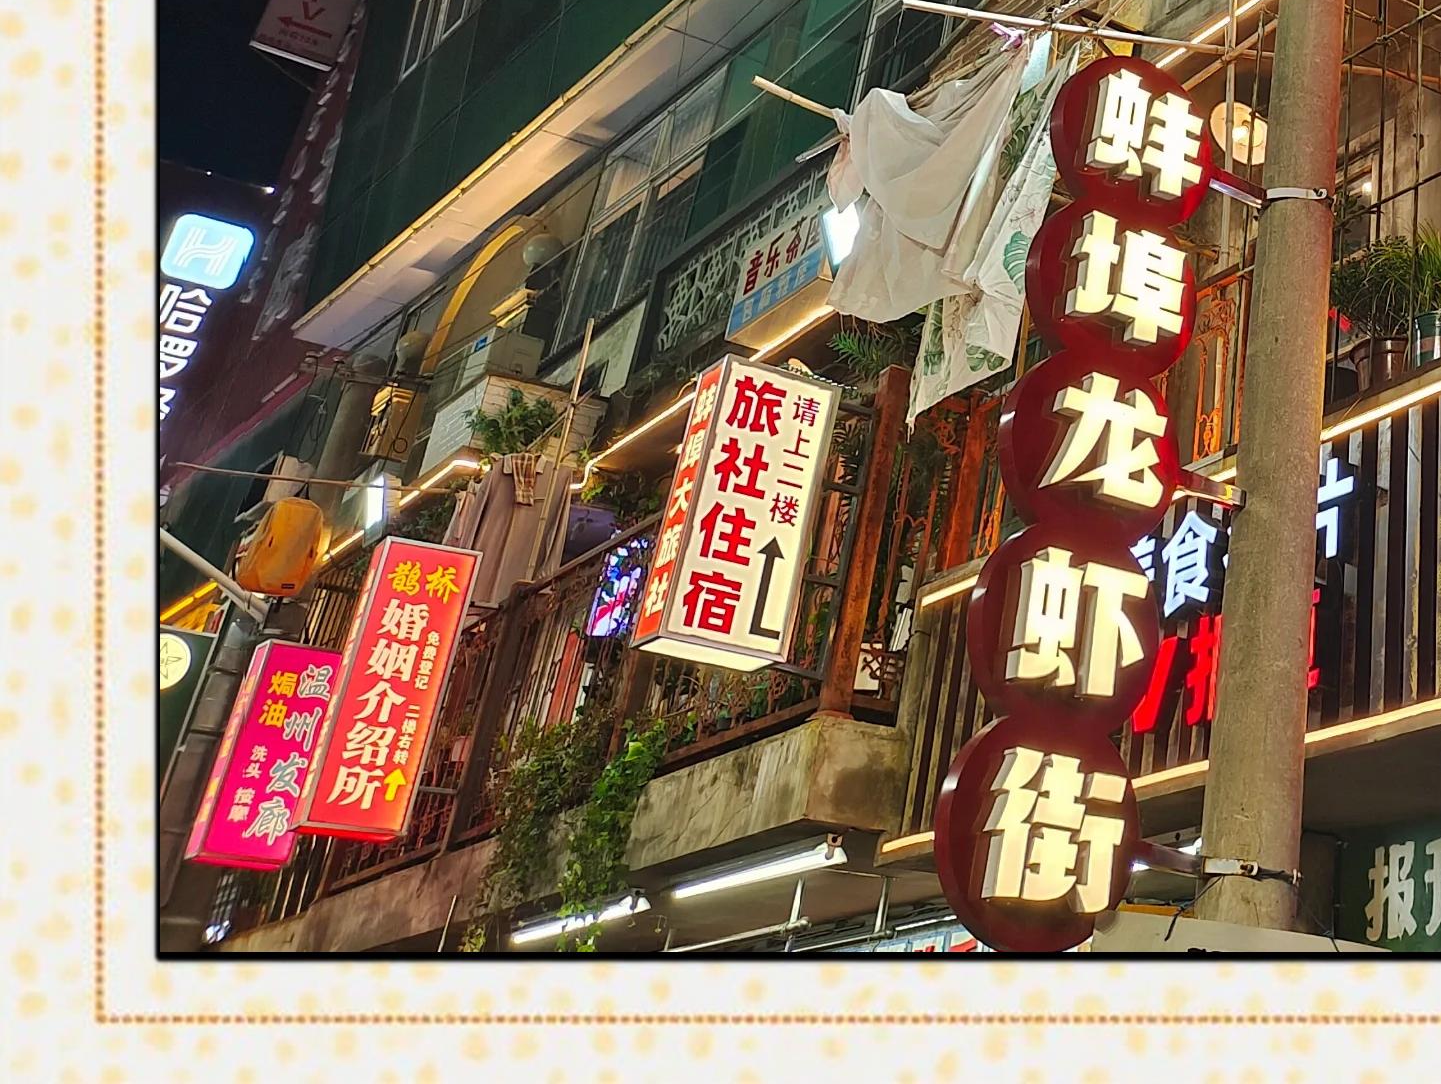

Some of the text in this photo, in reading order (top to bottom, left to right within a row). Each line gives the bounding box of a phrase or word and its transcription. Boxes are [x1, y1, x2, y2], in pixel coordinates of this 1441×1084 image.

[743, 204, 821, 296] 音乐茶座
[645, 385, 716, 618] 蚌埠大旅社
[682, 374, 787, 635] 旅社住宿
[768, 394, 822, 528] 请上二楼
[980, 68, 1204, 914] 蚌埠龙虾街
[386, 560, 461, 606] 鹊桥
[258, 670, 298, 729] 焗油
[326, 598, 430, 811] 婚姻介绍所
[413, 630, 442, 691] 免费登记
[242, 664, 334, 847] 温州发廊
[242, 744, 269, 780] 洗头
[392, 703, 422, 766] 二楼右转
